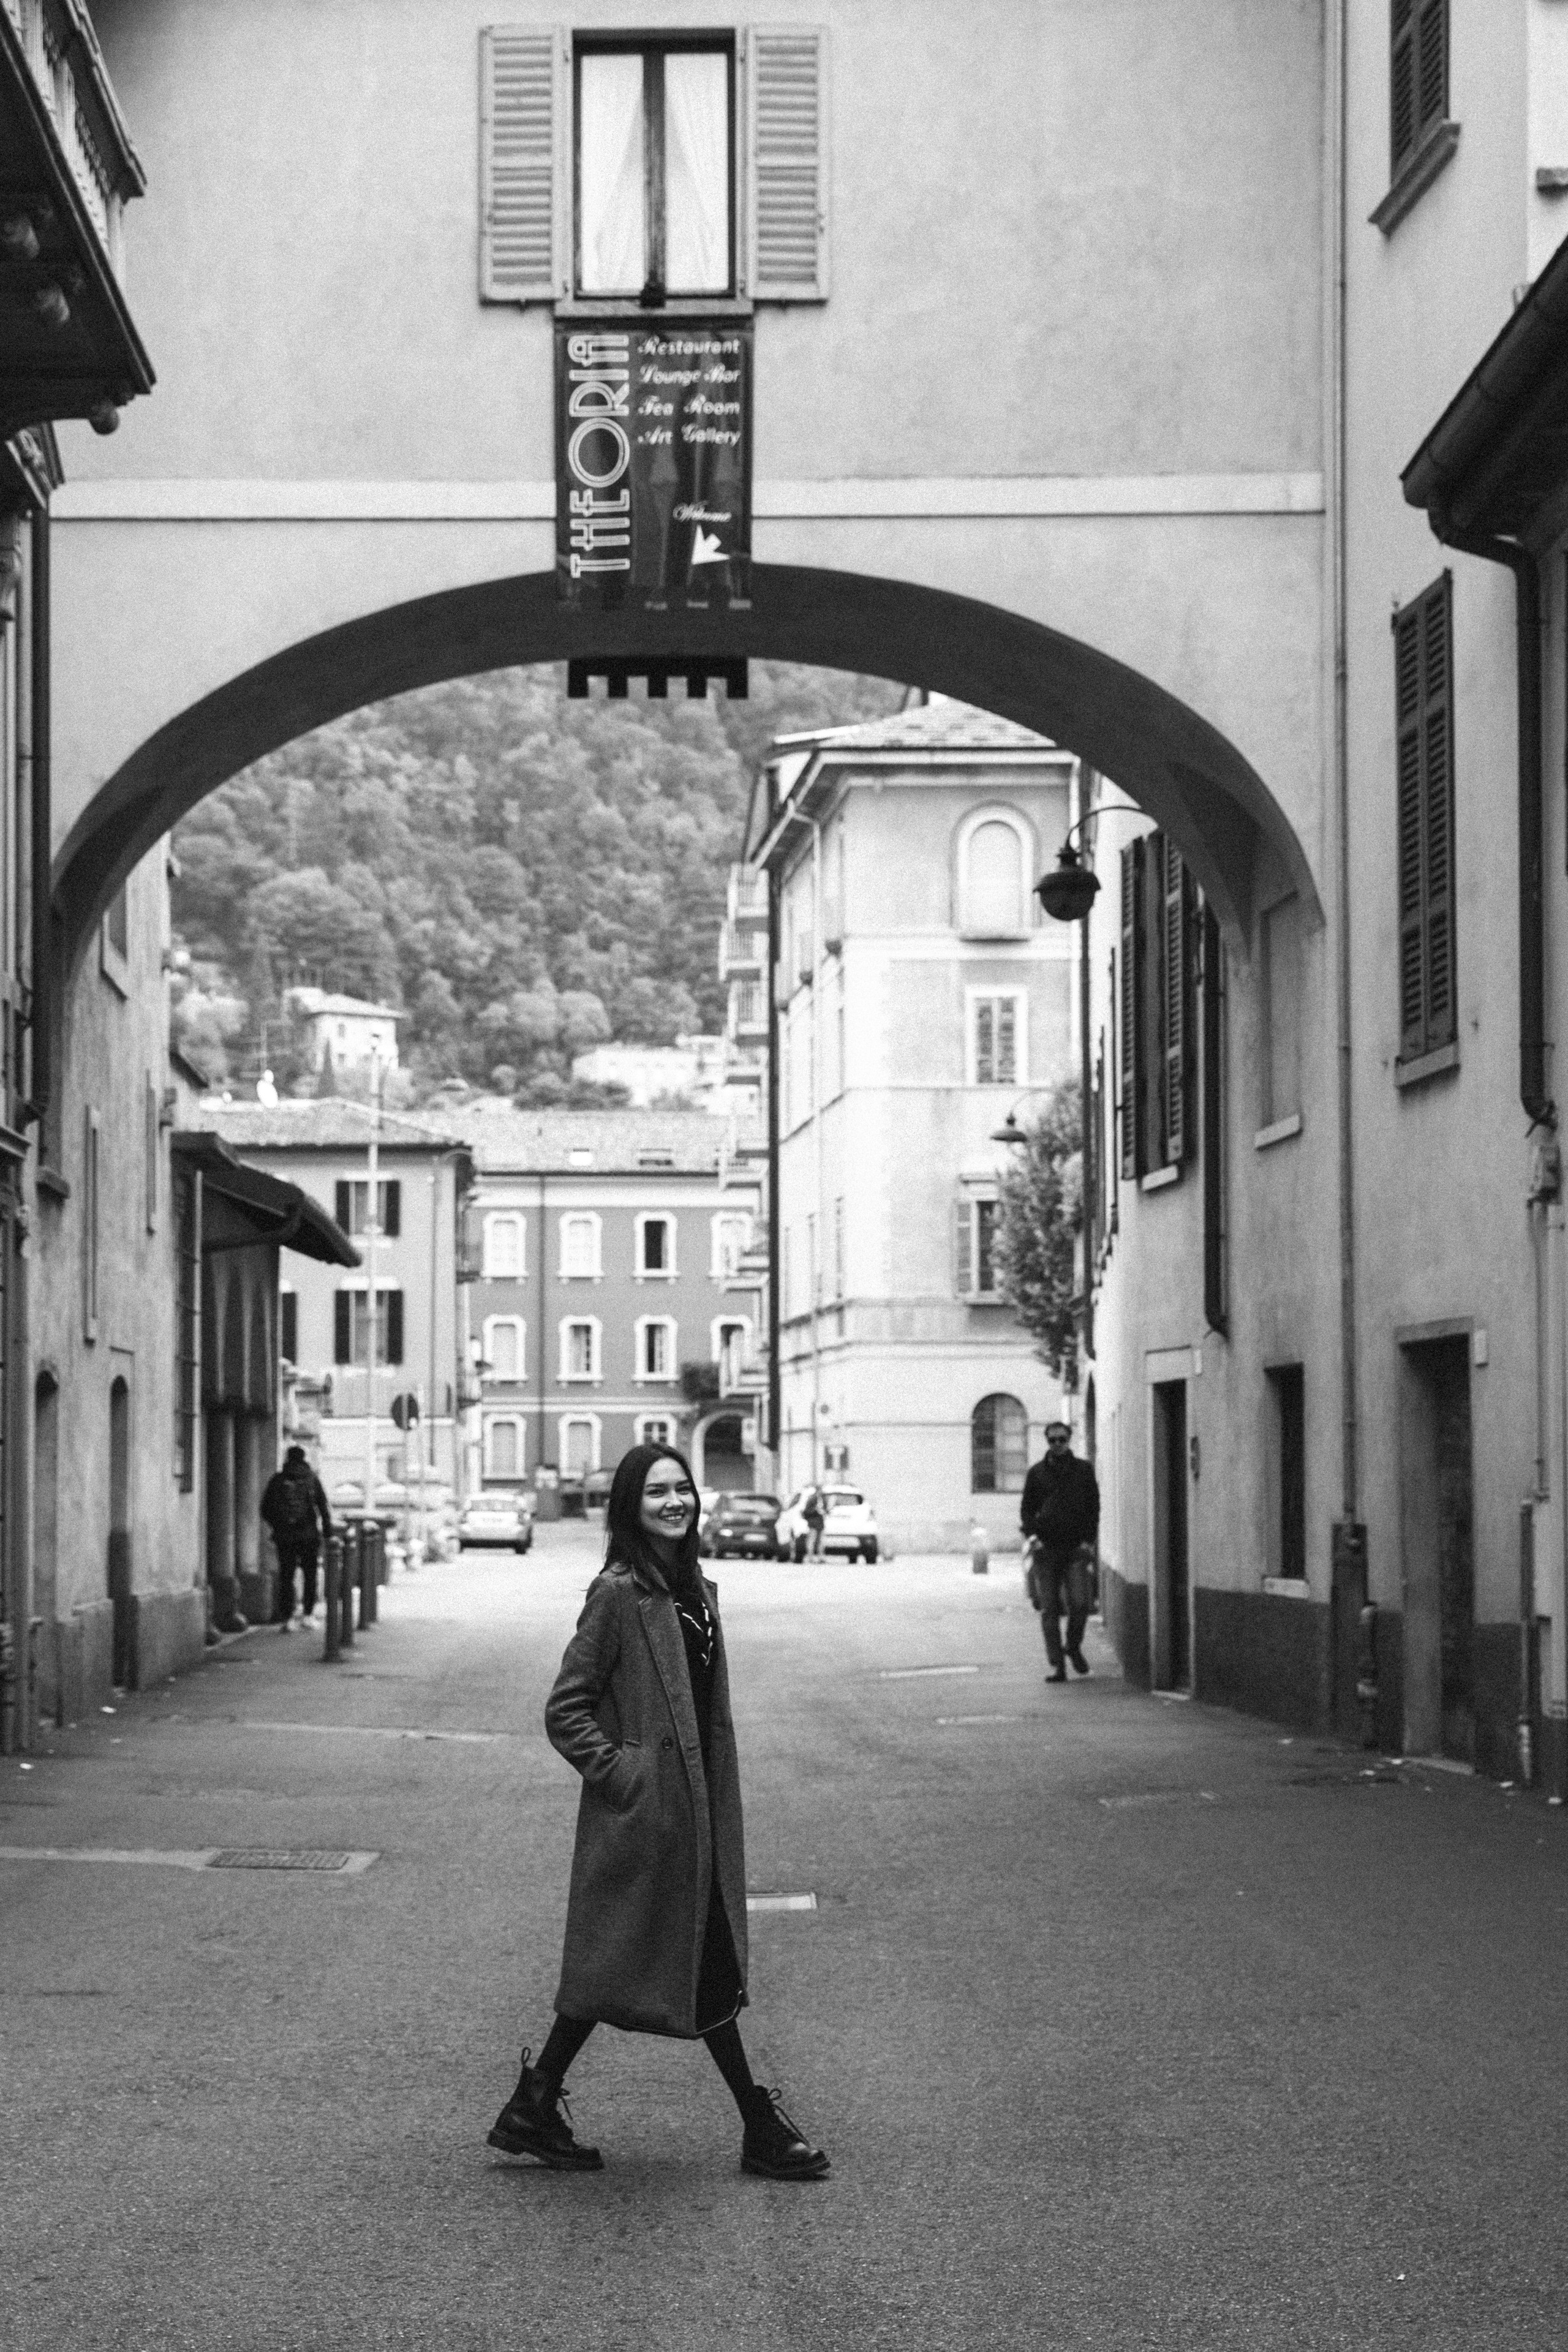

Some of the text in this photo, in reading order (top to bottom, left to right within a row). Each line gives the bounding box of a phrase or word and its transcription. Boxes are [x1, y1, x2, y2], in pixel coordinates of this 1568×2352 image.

[638, 336, 739, 356] Restaurant
[640, 365, 701, 386] Lounge
[638, 394, 741, 416] Tea Room
[681, 424, 741, 447] Gallery
[568, 334, 630, 578] THEORIA
